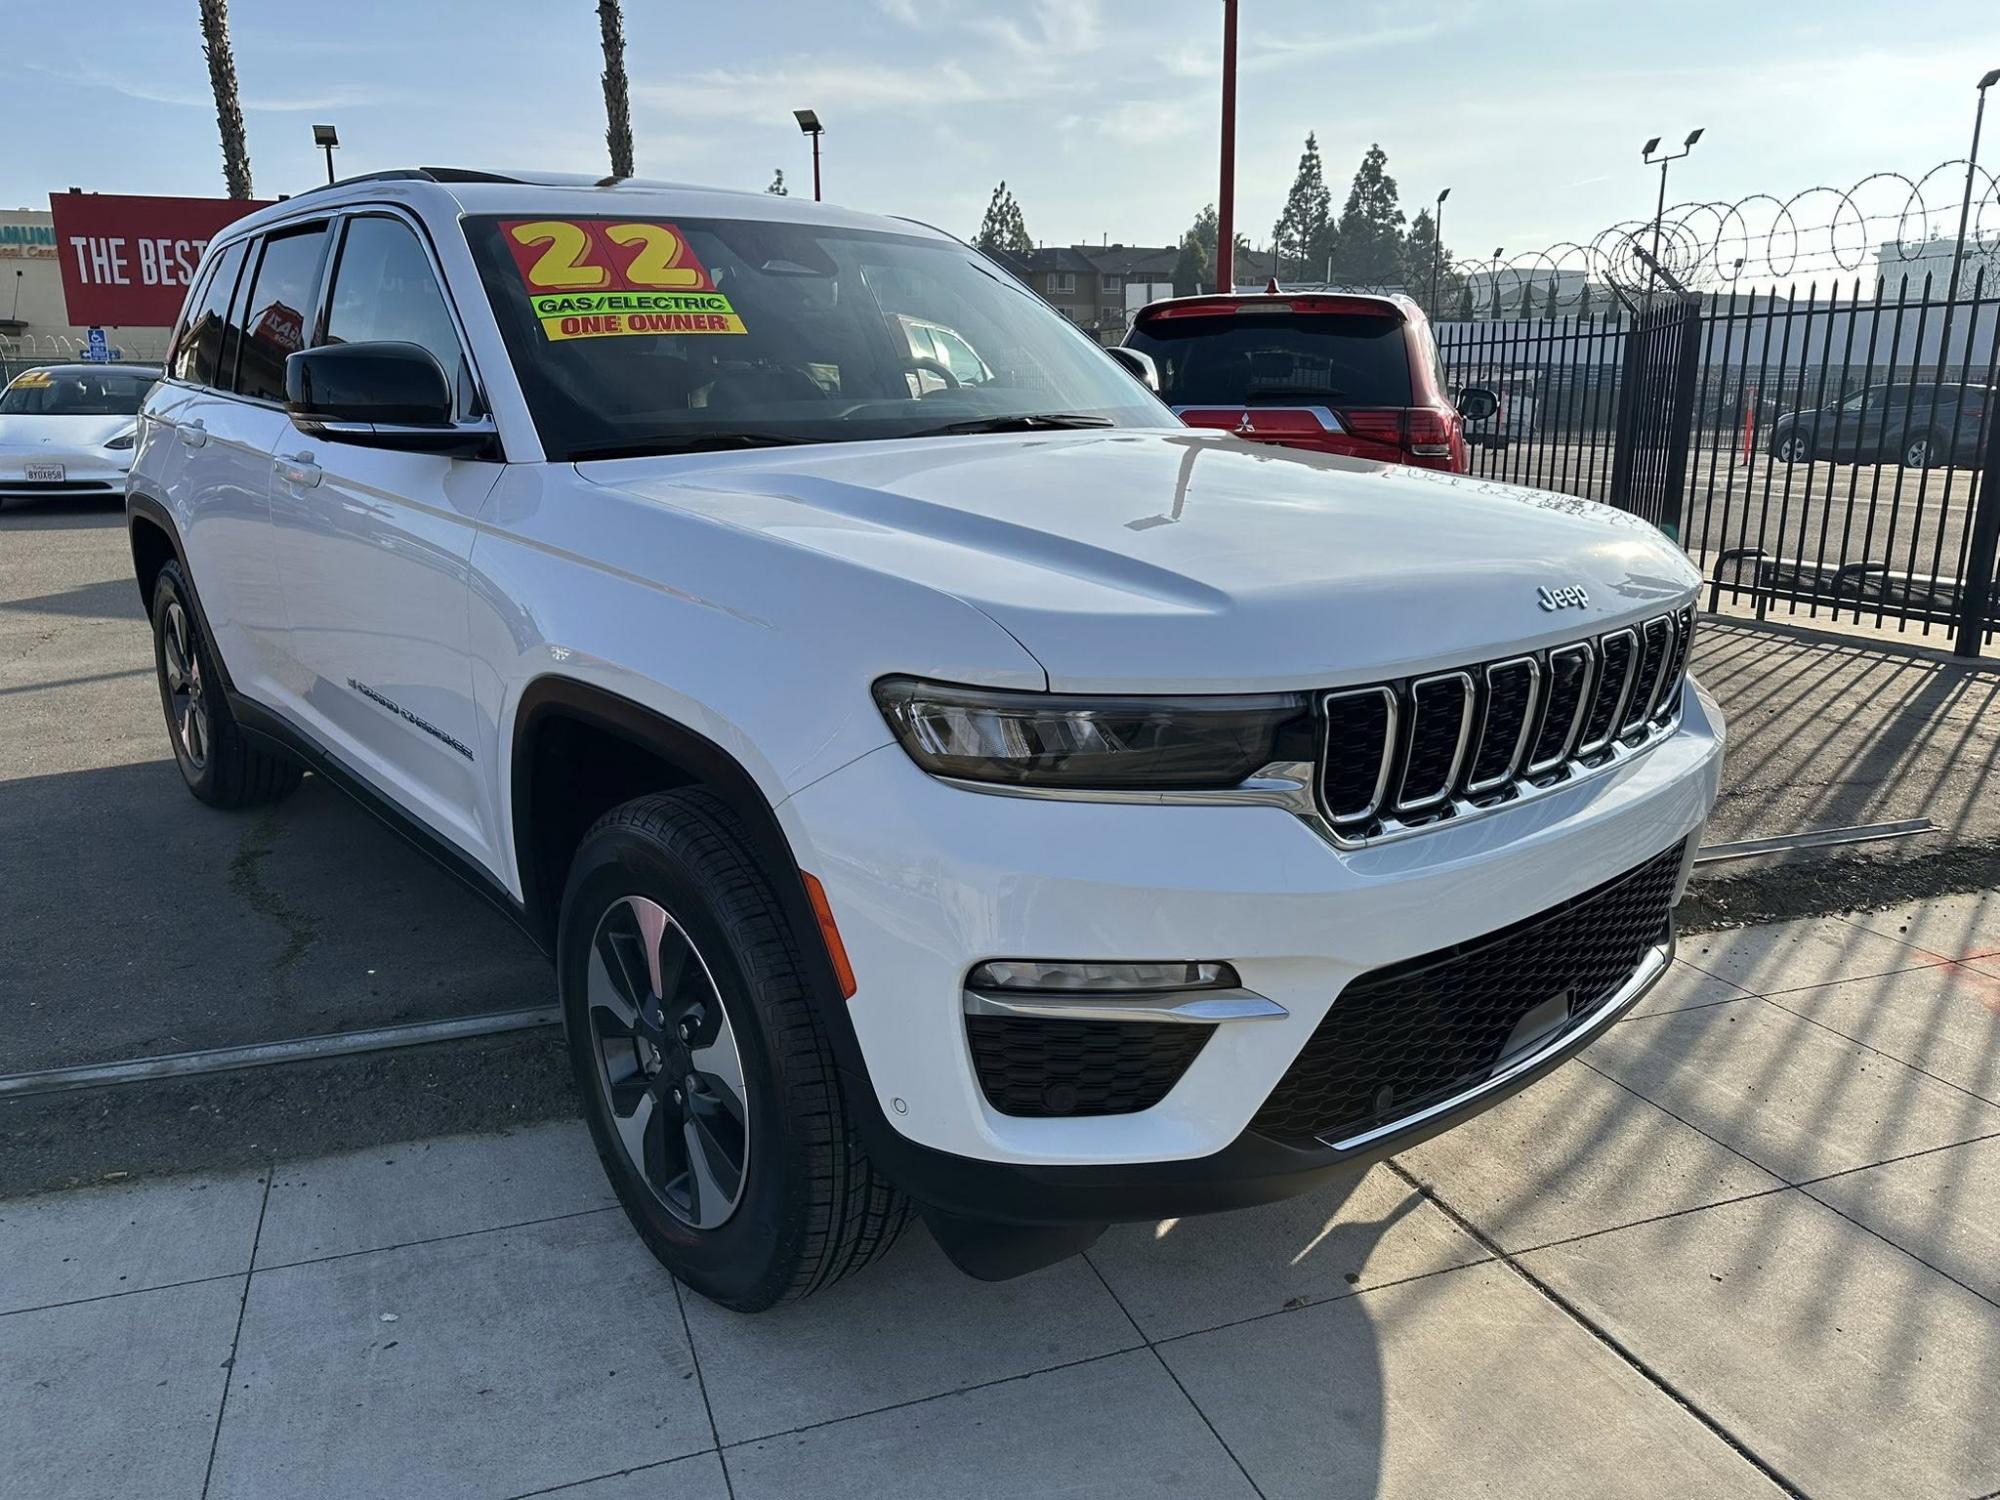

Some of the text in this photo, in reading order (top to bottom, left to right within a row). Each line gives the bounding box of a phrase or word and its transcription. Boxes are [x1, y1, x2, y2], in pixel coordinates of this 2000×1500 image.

[70, 236, 208, 286] THE BEST
[511, 221, 704, 289] 22
[538, 296, 725, 314] GAS/ELECTRIC
[560, 314, 730, 336] ONE OWNER
[1536, 584, 1589, 612] Jeep
